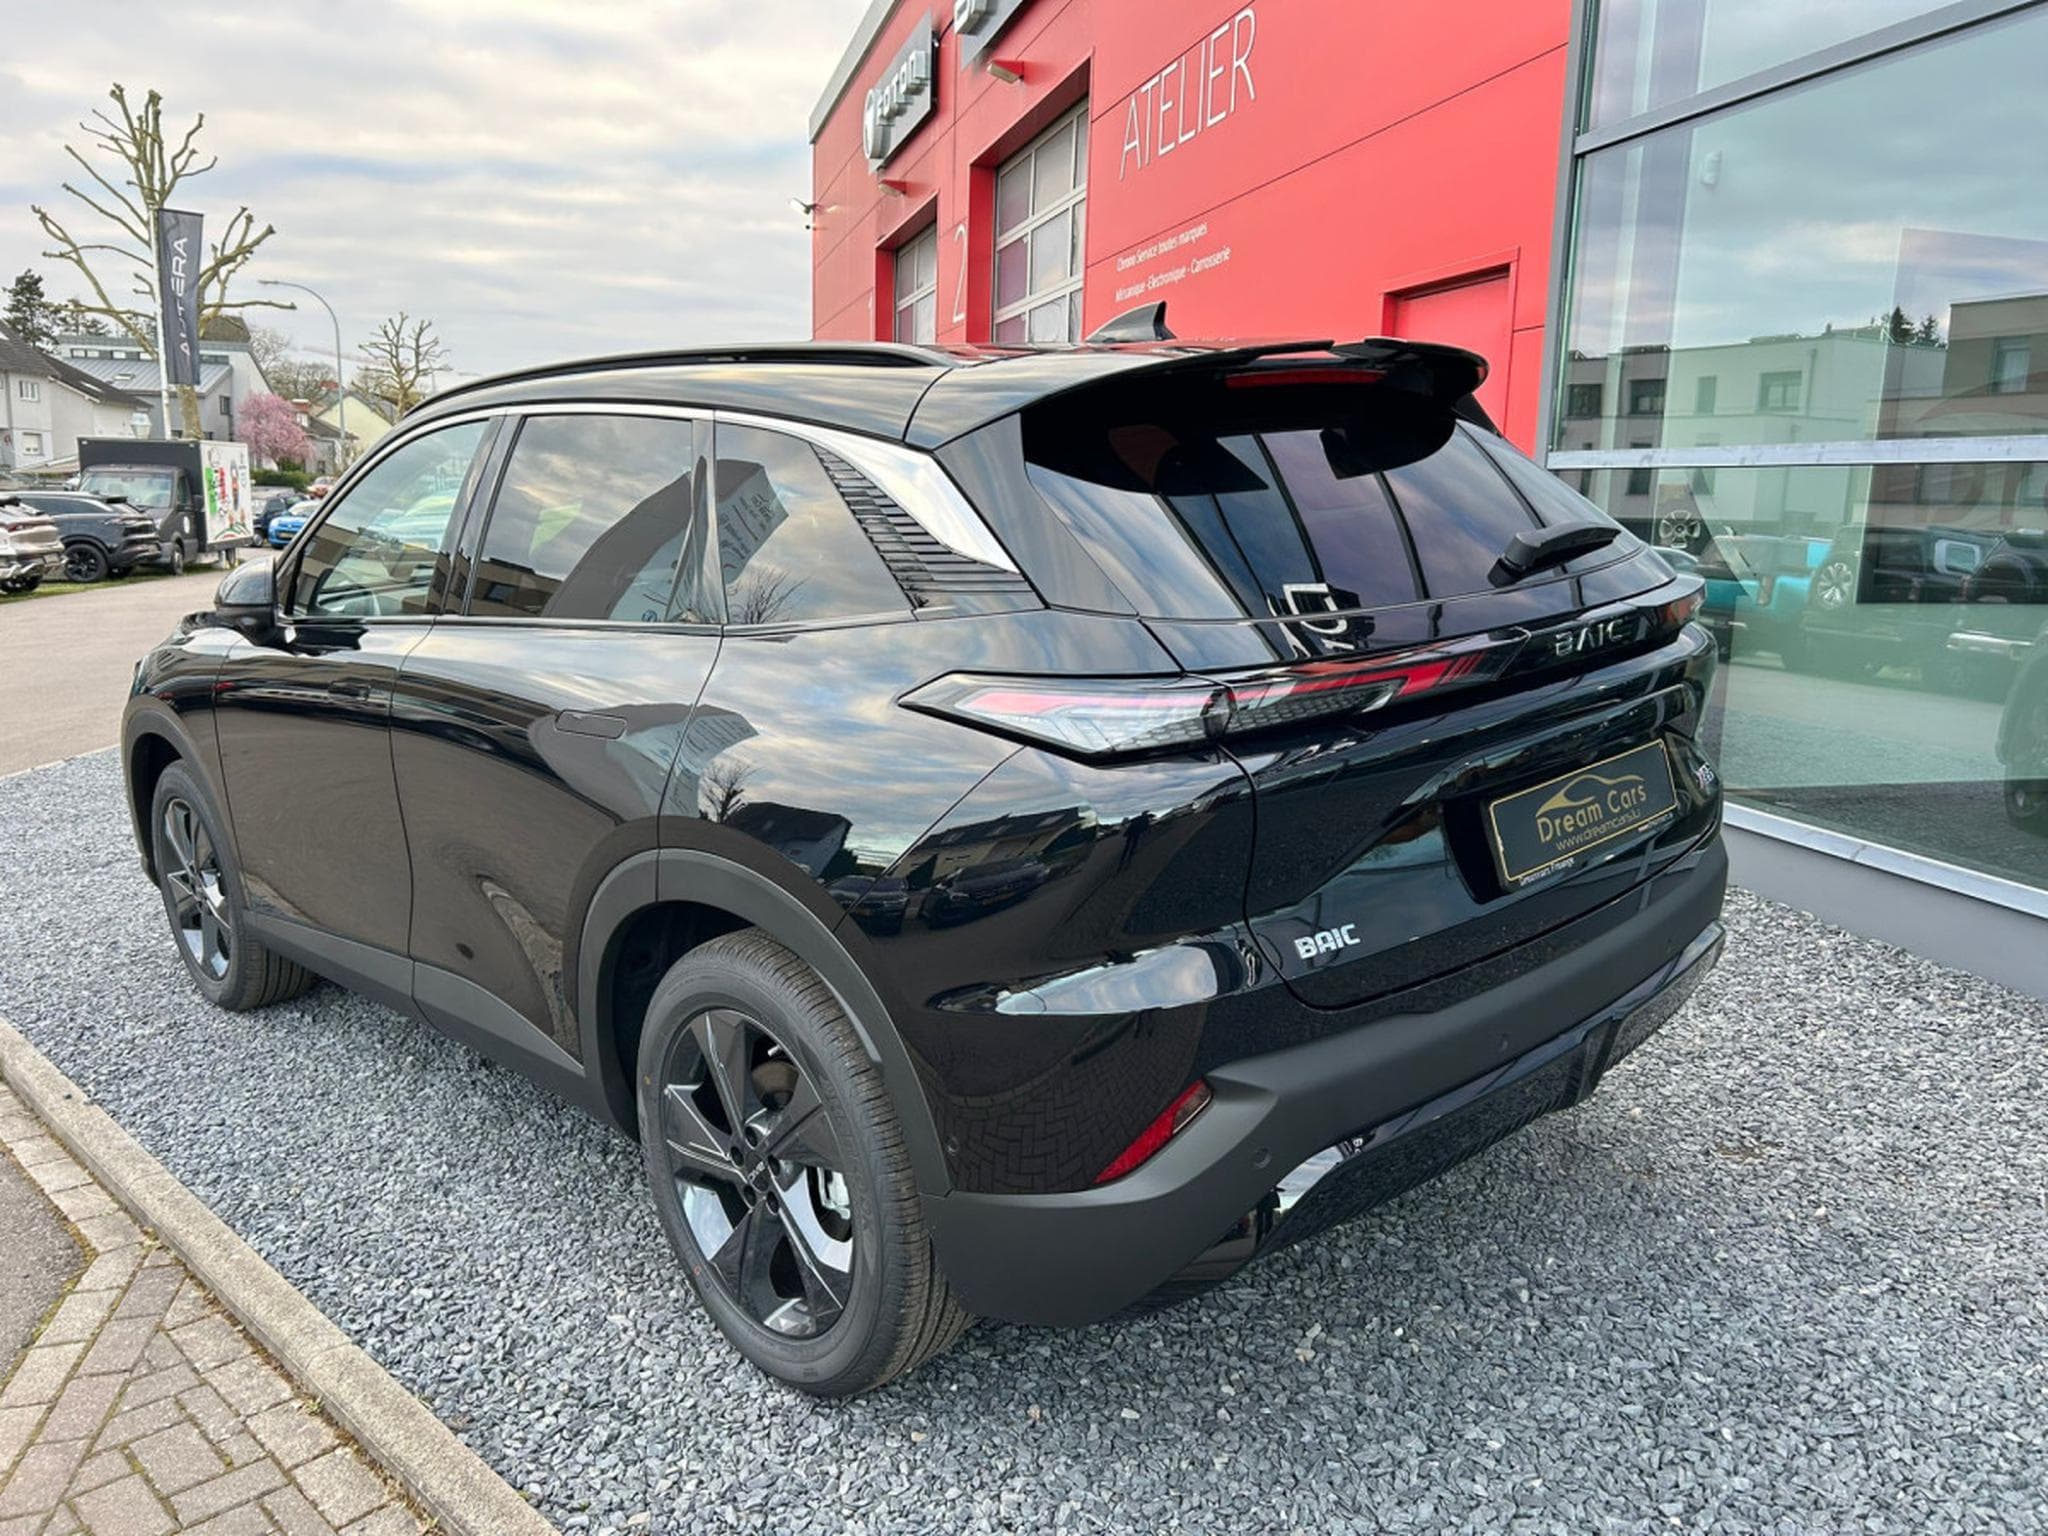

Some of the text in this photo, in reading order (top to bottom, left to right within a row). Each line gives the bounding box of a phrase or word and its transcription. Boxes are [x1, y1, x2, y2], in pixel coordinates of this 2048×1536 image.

[1119, 8, 1257, 182] ATELIER
[952, 222, 967, 323] 2
[1554, 617, 1629, 657] BAIC
[1536, 801, 1603, 844] Dream
[1607, 784, 1648, 814] Cars
[1294, 924, 1361, 960] BAIC
